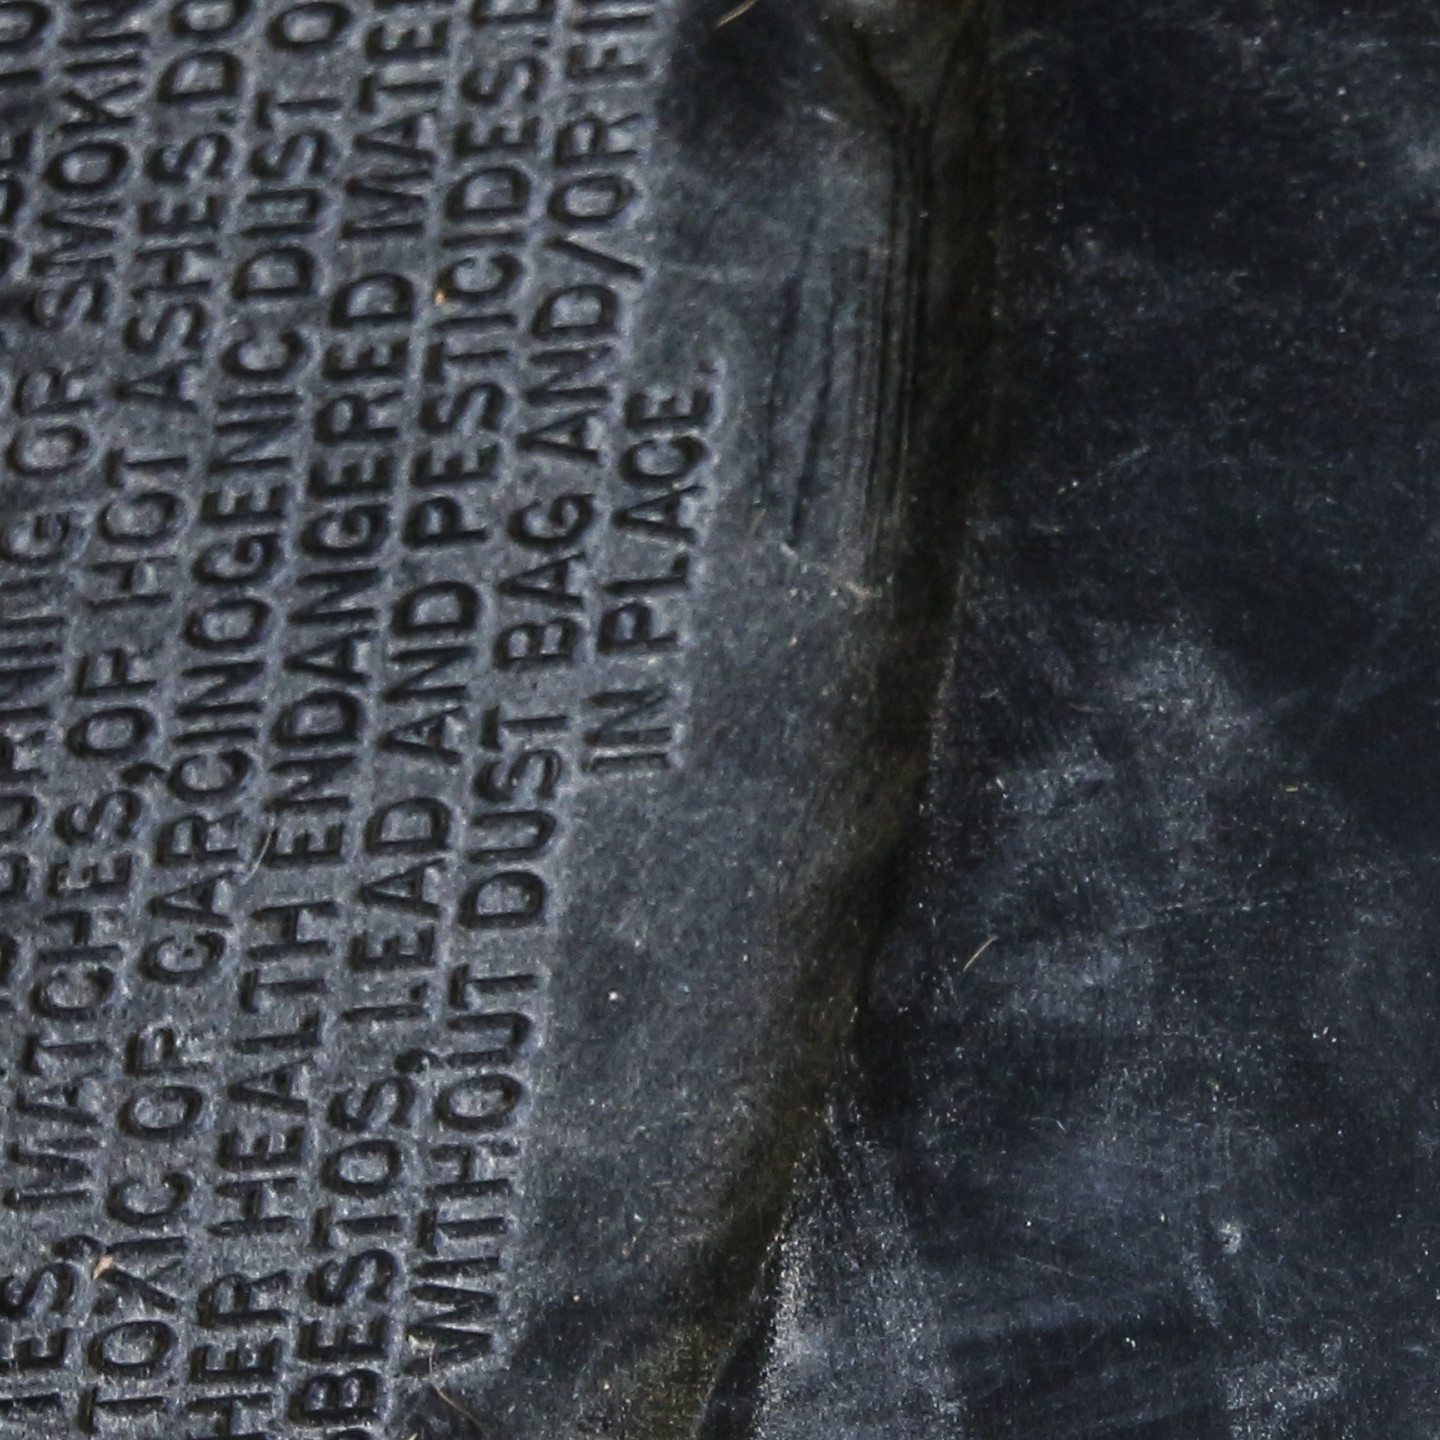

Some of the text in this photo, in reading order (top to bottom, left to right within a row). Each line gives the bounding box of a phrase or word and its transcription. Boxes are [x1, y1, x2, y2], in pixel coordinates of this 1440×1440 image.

[6, 368, 100, 477] OR
[515, 113, 640, 468] AND/OR
[83, 450, 188, 605] HOT
[255, 270, 415, 868] ENDANGERED
[492, 495, 595, 667] BAG
[582, 392, 707, 775] IN PLACE
[76, 1172, 192, 1435] TOXIC
[135, 328, 305, 990] CARCINOGENIC
[230, 95, 340, 303] DUST
[378, 582, 480, 765] AND
[338, 798, 450, 1027] LEAD
[457, 705, 568, 930] DUST
[205, 902, 338, 1240] HEALTH
[402, 965, 538, 1377] WITHOUT
